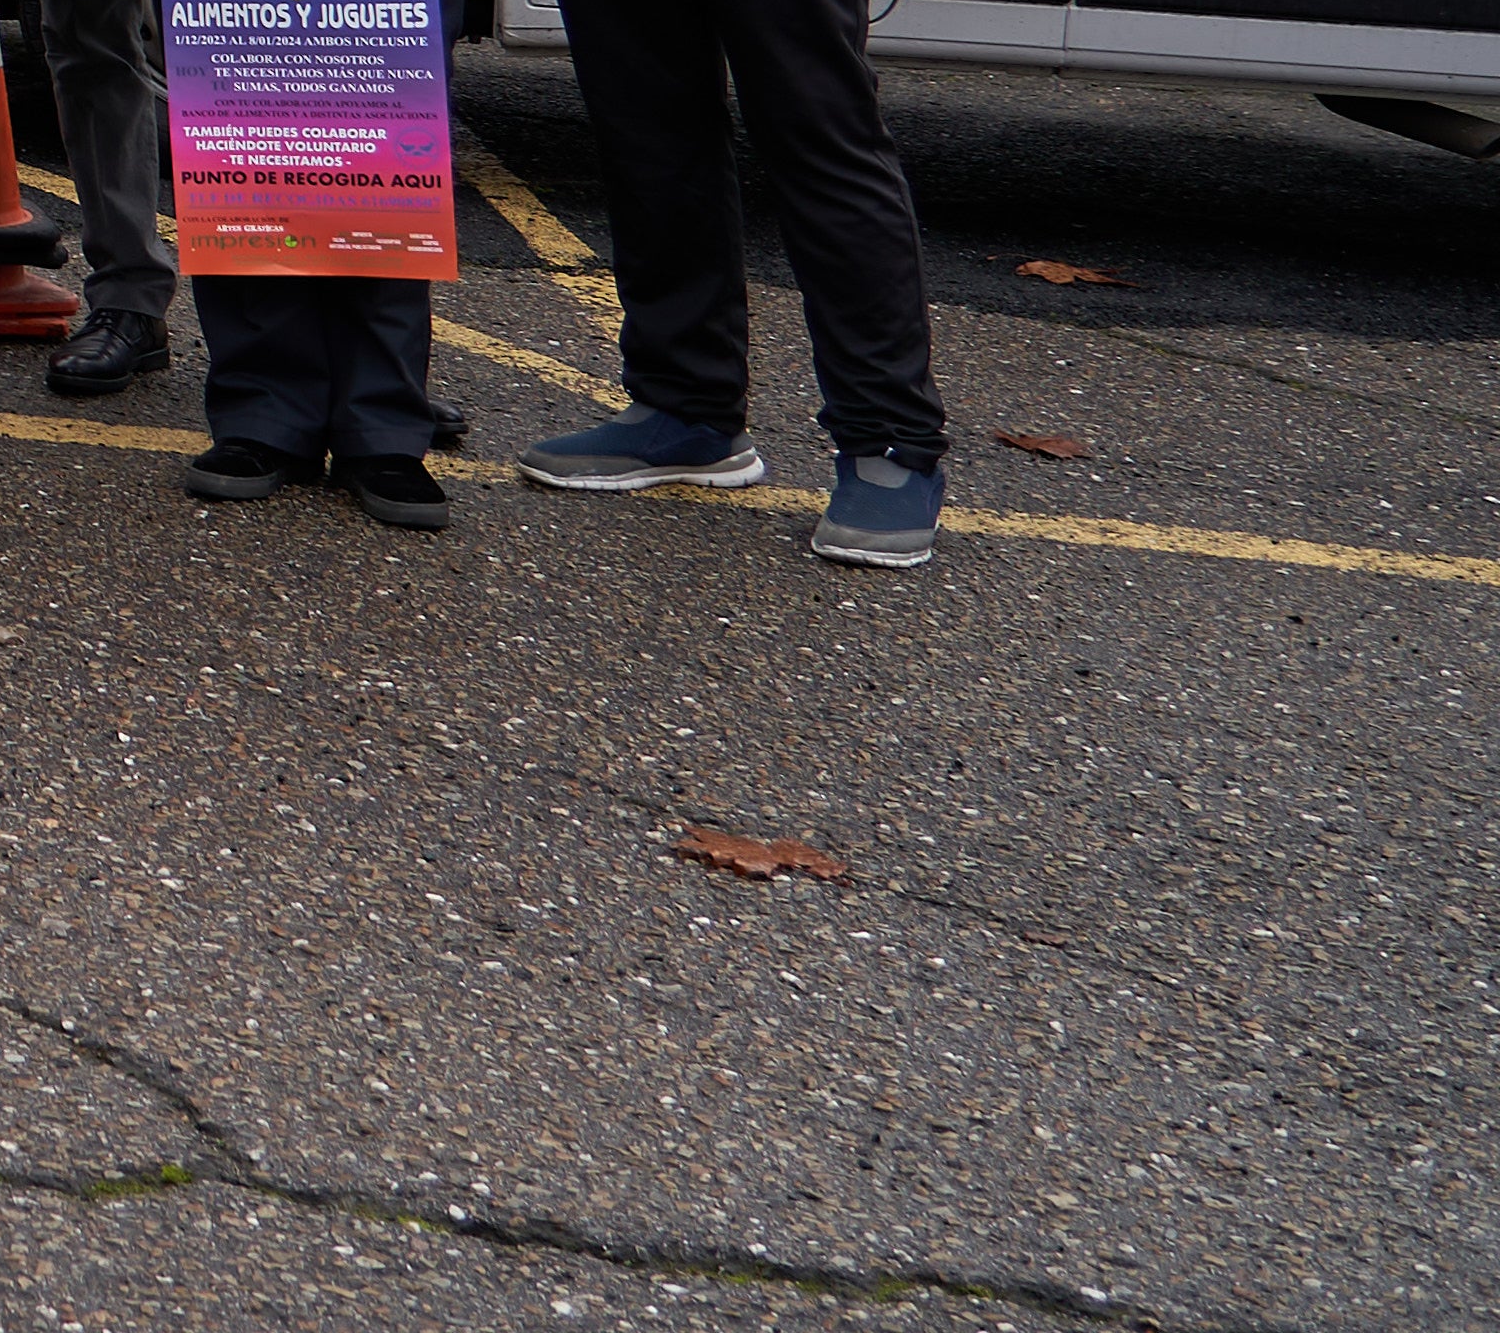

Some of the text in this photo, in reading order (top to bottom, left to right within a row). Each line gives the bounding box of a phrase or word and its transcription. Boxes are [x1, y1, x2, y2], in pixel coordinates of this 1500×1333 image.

[170, 1, 429, 28] ALIMENTOS Y JUGUETES
[182, 171, 441, 188] PUNTO DE RECOGIDA AQUI
